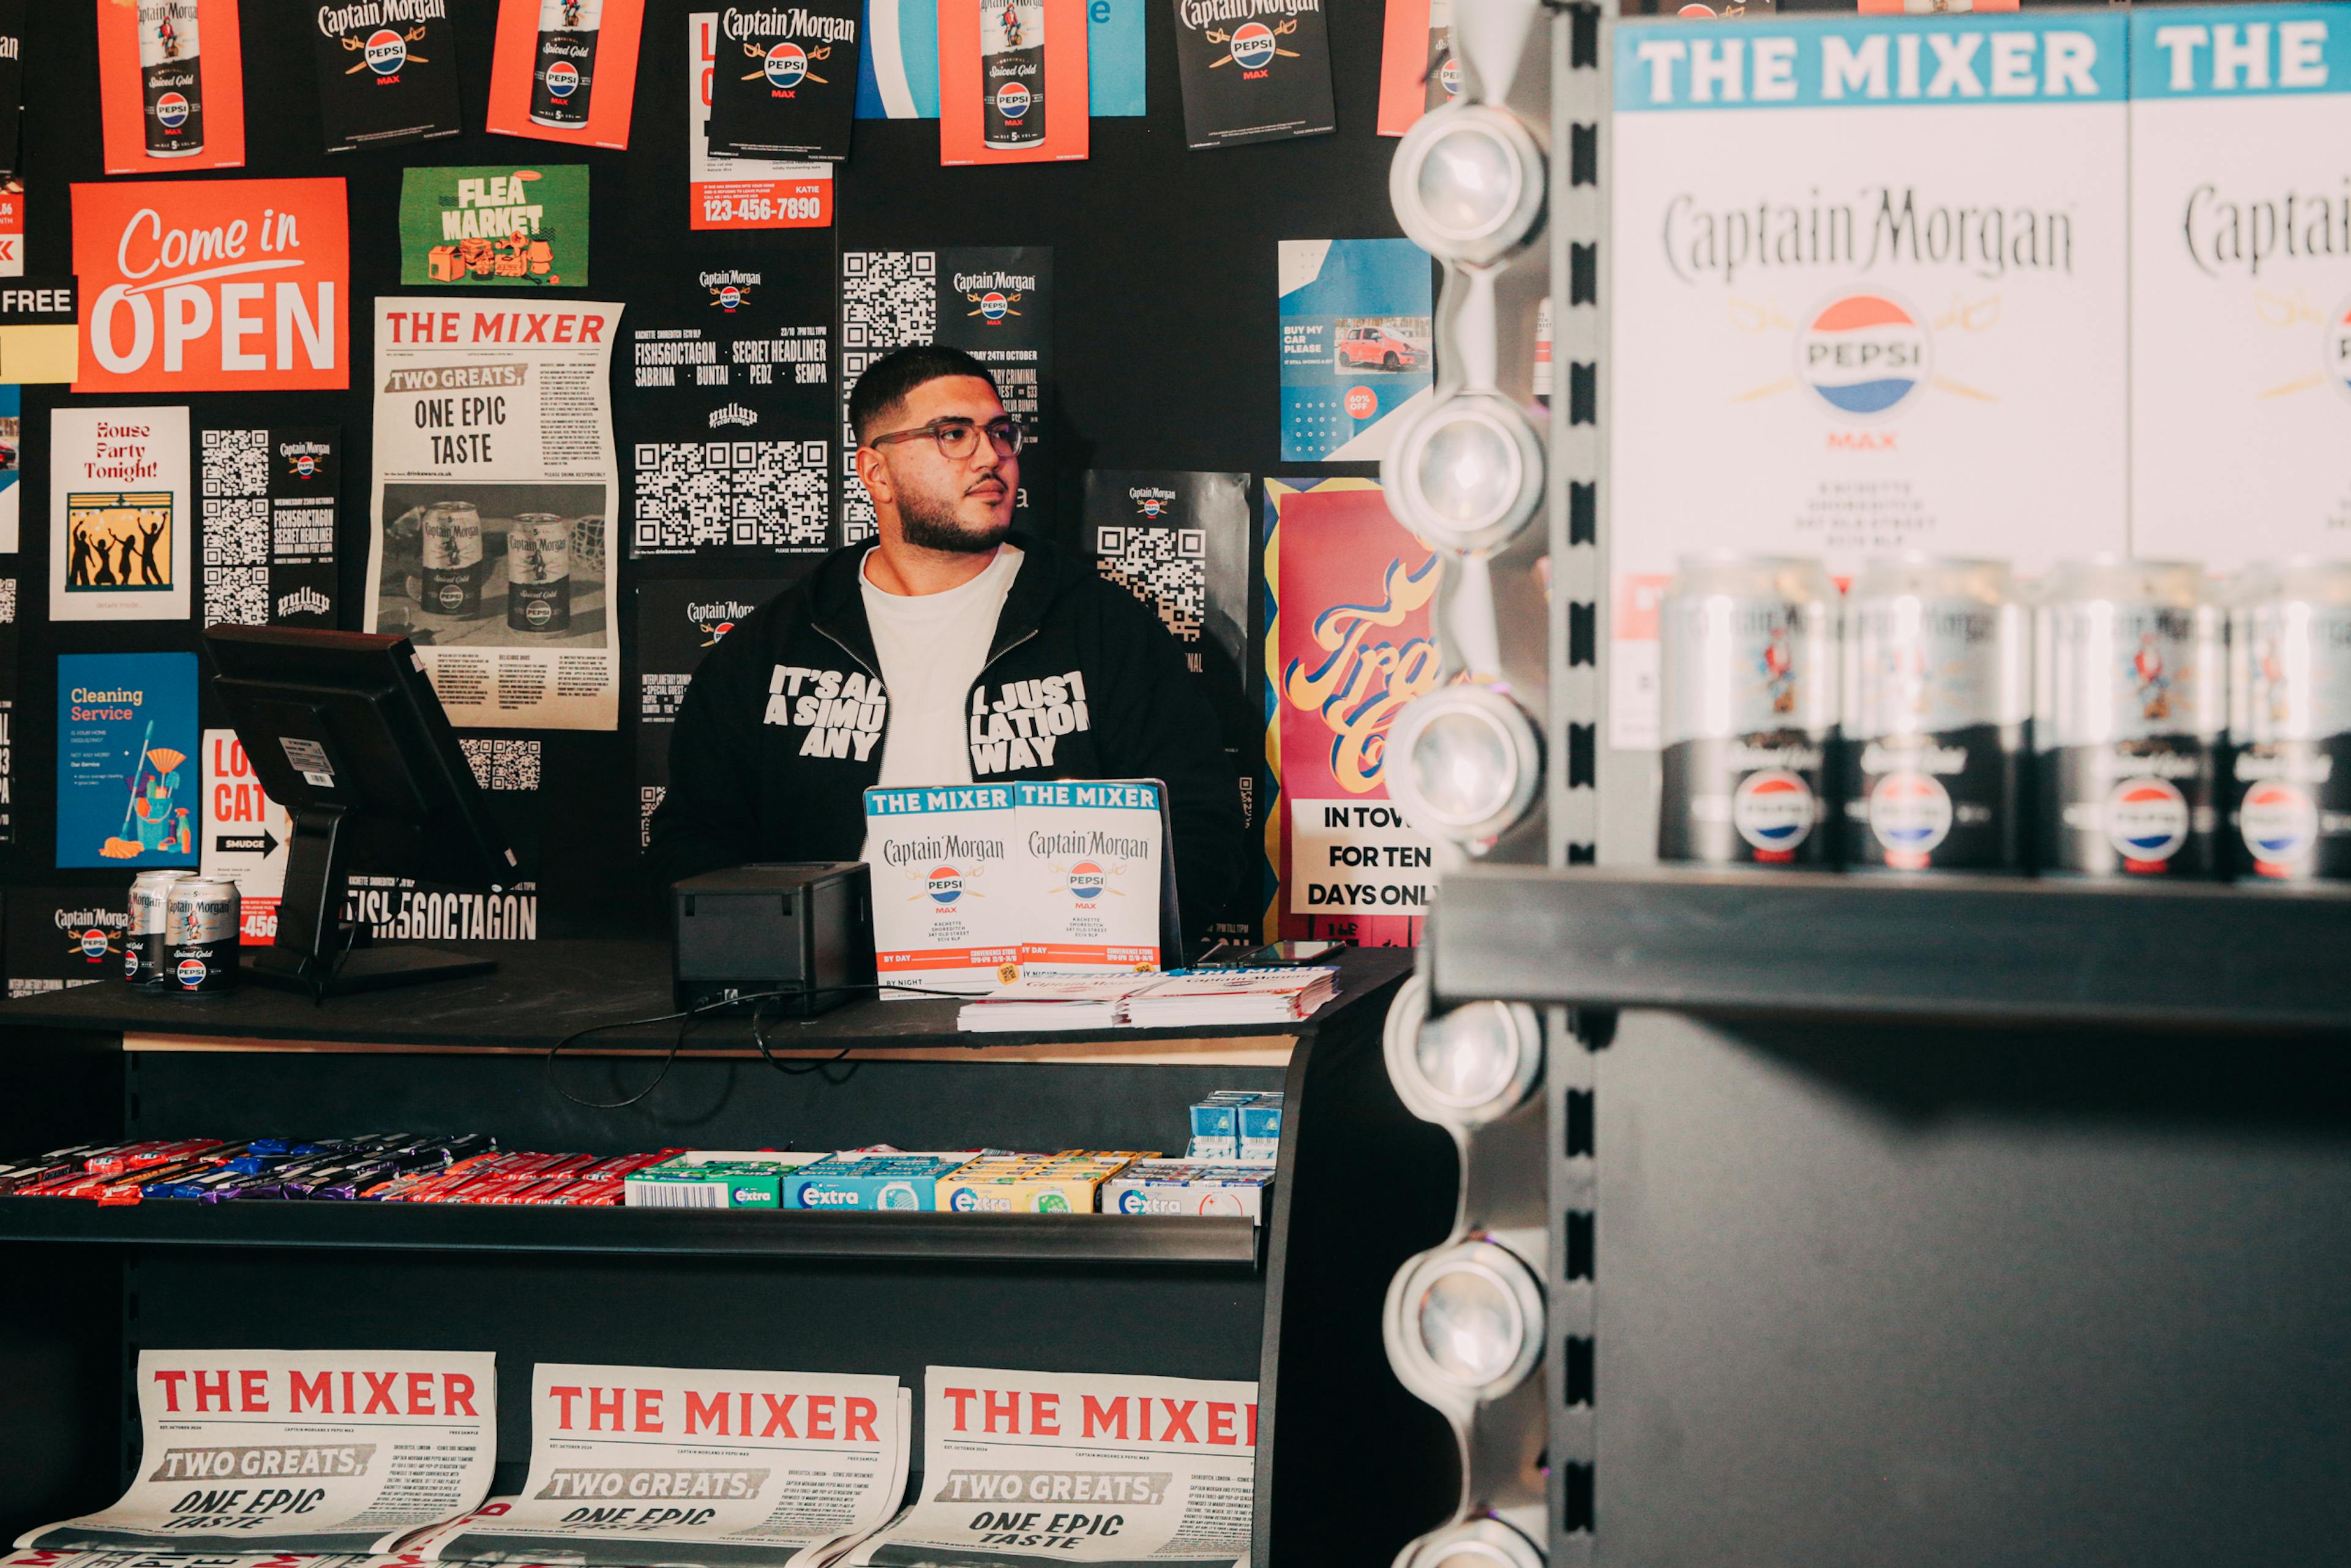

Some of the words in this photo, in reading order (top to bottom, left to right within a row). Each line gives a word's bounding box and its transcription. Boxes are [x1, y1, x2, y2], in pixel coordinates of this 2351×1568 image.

[318, 0, 381, 37] Captain
[380, 0, 446, 26] Morgan
[723, 7, 787, 41] Captain
[786, 9, 855, 43] Morgan
[368, 46, 403, 59] PEPSI
[543, 42, 570, 55] Spiced
[569, 45, 589, 58] Gold
[1234, 40, 1272, 53] PEPSI
[2154, 20, 2328, 92] THE
[768, 60, 804, 71] PEPSI
[989, 66, 1017, 77] Spiced
[1018, 64, 1037, 77] Gold
[1243, 70, 1269, 80] MAX
[1637, 38, 1799, 103] THE
[1820, 30, 2100, 100] MIXER
[176, 74, 193, 87] Gold
[377, 75, 400, 86] MAX
[549, 73, 577, 84] PEPSI
[771, 90, 796, 99] MAX
[159, 103, 187, 114] PEPSI
[458, 176, 527, 209] FLEA
[796, 186, 820, 194] KATIE
[703, 197, 820, 222] 123-456-7890
[441, 204, 544, 241] MARKET
[117, 208, 249, 279] Come
[261, 209, 300, 253] in
[1662, 188, 1855, 284] Captain
[1851, 186, 2074, 279] Morgan
[699, 270, 730, 288] Captain
[729, 270, 762, 286] Morgan
[953, 272, 994, 293] Captain
[992, 272, 1036, 292] Morgan
[2, 289, 72, 313] FREE
[90, 282, 335, 375] OPEN
[386, 312, 460, 343] THE
[471, 313, 605, 343] MIXER
[1284, 326, 1305, 336] BUY
[1306, 325, 1324, 335] MY
[1284, 335, 1307, 344] CAR
[1284, 344, 1322, 353] PLEASE
[732, 340, 770, 364] SECRET
[771, 339, 827, 362] HEADLINER
[988, 350, 1005, 361] 24TH
[1005, 350, 1038, 361] OCTOBER
[1805, 340, 1921, 369] PEPSI
[391, 370, 440, 391] TWO
[441, 367, 522, 388] GREATS,
[635, 366, 675, 387] SABRINA
[696, 365, 729, 386] BUNTAI
[749, 364, 773, 385] PEDZ
[795, 363, 827, 384] SEMPA
[1006, 369, 1038, 385] CRIMINAL
[1349, 394, 1370, 403] 60%
[1349, 402, 1368, 411] OFF
[414, 399, 454, 429] ONE
[462, 396, 506, 427] EPIC
[97, 421, 151, 438] House
[280, 442, 307, 457] Captain
[306, 442, 331, 457] Morgan
[430, 433, 493, 465] TASTE
[1827, 431, 1899, 451] MAX
[96, 442, 146, 462] Party
[84, 462, 157, 482] Tonight!
[1129, 487, 1153, 500] Captain
[1152, 487, 1176, 500] Morgan
[274, 527, 300, 544] SECRET
[510, 536, 538, 552] Captain
[687, 601, 726, 623] Captain
[768, 664, 844, 700] IT'S
[992, 670, 1087, 713] JUST
[70, 687, 143, 707] Cleaning
[70, 705, 133, 721] Service
[763, 694, 789, 726] A
[793, 695, 887, 733] SIMU
[970, 700, 1092, 745] LATION
[798, 726, 882, 762] ANY
[970, 735, 1057, 776] WAY
[214, 783, 265, 822] CAT
[872, 793, 921, 814] THE
[924, 789, 1009, 811] MIXER
[1021, 786, 1072, 805] THE
[1074, 786, 1156, 809] MIXER
[1324, 807, 1349, 828] IN
[225, 839, 265, 849] SMUDGE
[883, 836, 943, 868] Captain
[941, 835, 1005, 862] Morgan
[1028, 830, 1087, 859] Captain
[1086, 830, 1149, 861] Morgan
[1329, 846, 1379, 867] FOR
[1383, 847, 1431, 868] TEN
[928, 880, 963, 890] PEPSI
[1070, 876, 1104, 885] PEPSI
[132, 892, 160, 908] Morgan
[1308, 883, 1376, 906] DAYS
[55, 908, 95, 929] Captain
[195, 901, 232, 915] Morgan
[174, 950, 195, 959] Spiced
[195, 949, 212, 958] Gold
[896, 955, 912, 963] DAY
[154, 1370, 271, 1413] THE
[289, 1371, 480, 1417] MIXER
[549, 1385, 665, 1433] THE
[683, 1390, 881, 1442] MIXER
[943, 1387, 1062, 1436] THE
[1080, 1394, 1258, 1447] MIXE
[167, 1452, 239, 1478] TWO
[241, 1449, 366, 1476] GREATS,
[552, 1472, 624, 1497] TWO
[629, 1471, 755, 1499] GREATS,
[949, 1474, 1023, 1499] TWO
[1029, 1476, 1158, 1504] GREATS,
[170, 1488, 253, 1514] ONE
[249, 1487, 326, 1514] EPIC
[160, 1516, 275, 1529] TASTE
[560, 1507, 637, 1523] ONE
[633, 1507, 716, 1525] EPIC
[968, 1511, 1041, 1532] ONE
[1044, 1514, 1125, 1536] EPIC
[979, 1533, 1086, 1550] TASTE
